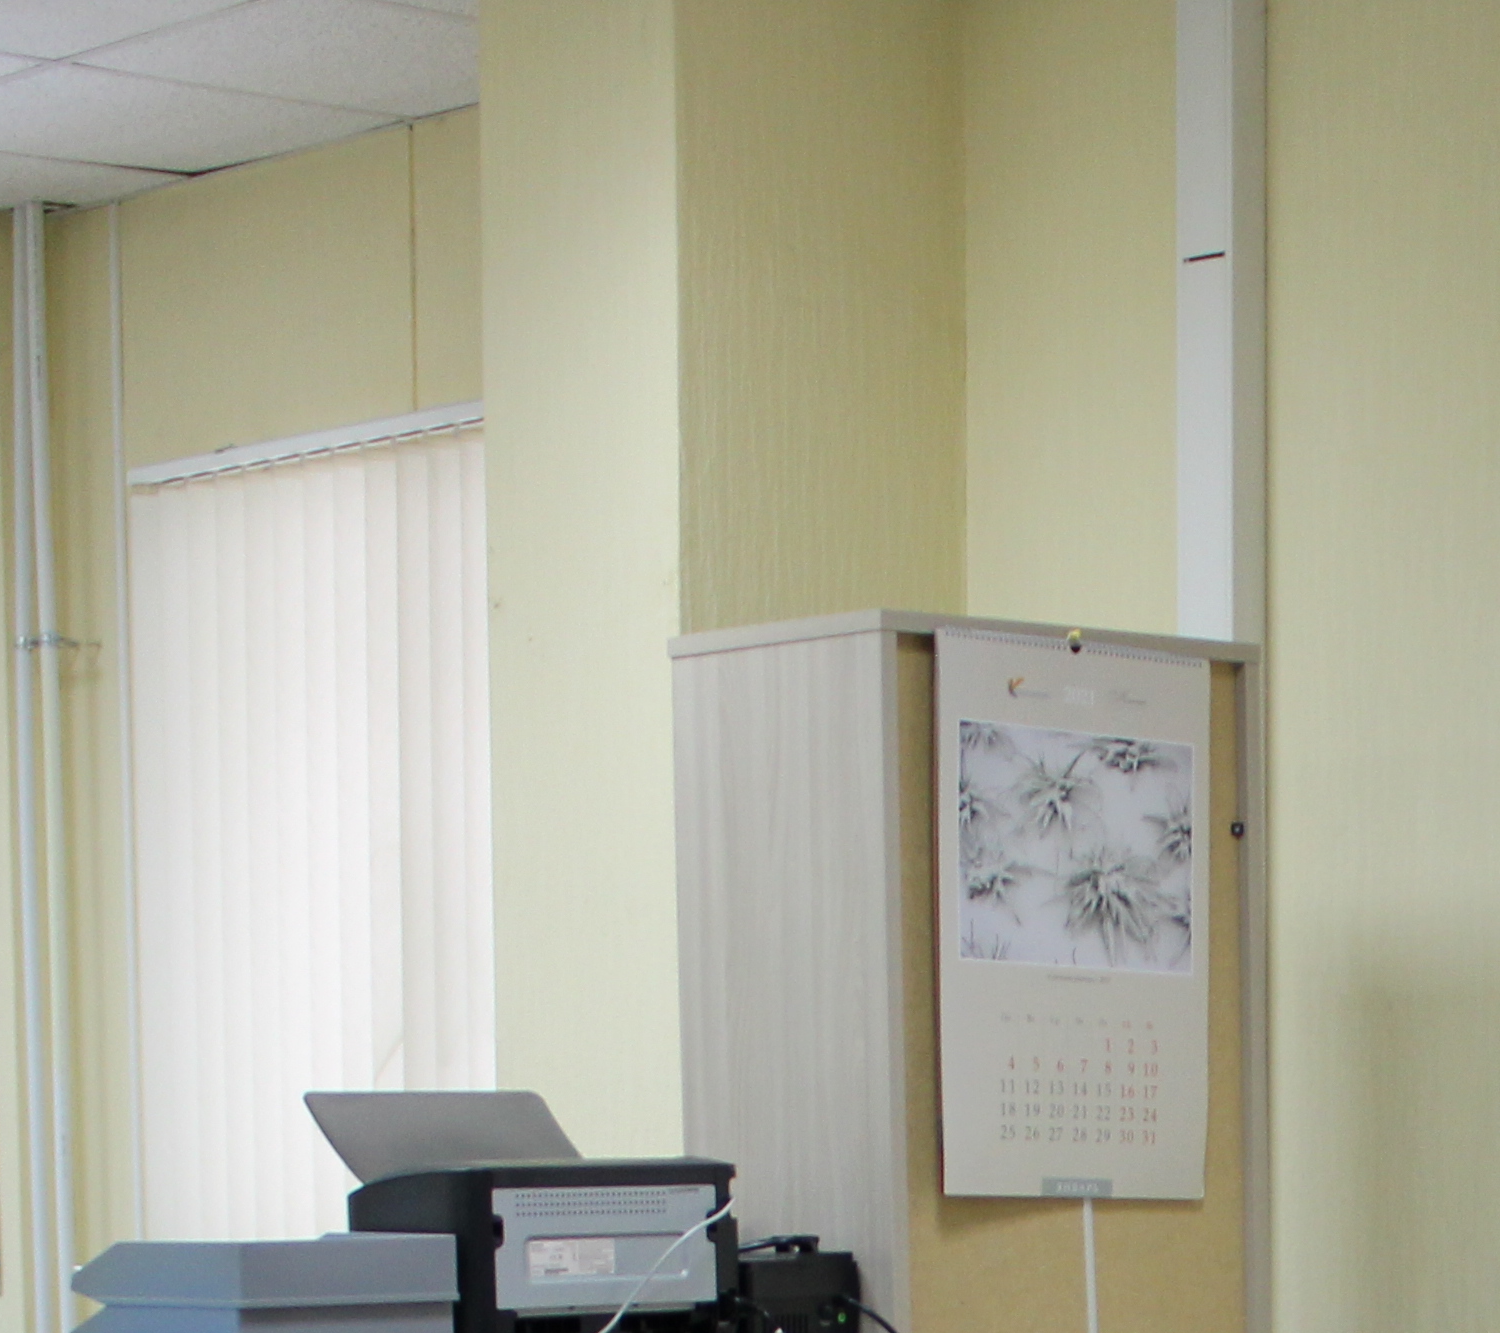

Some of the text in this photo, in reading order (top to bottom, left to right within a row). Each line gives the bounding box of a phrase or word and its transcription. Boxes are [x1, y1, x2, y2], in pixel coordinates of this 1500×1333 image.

[1105, 1037, 1158, 1055] 1 2 3
[1008, 1055, 1158, 1077] 4 5 6 7 8 9 10
[1000, 1079, 1158, 1099] 11 12 13 14 15 16 17
[1000, 1102, 1158, 1123] 18 19 20 21 22 23 24
[1000, 1124, 1157, 1145] 25 26 27 28 29 30 31
